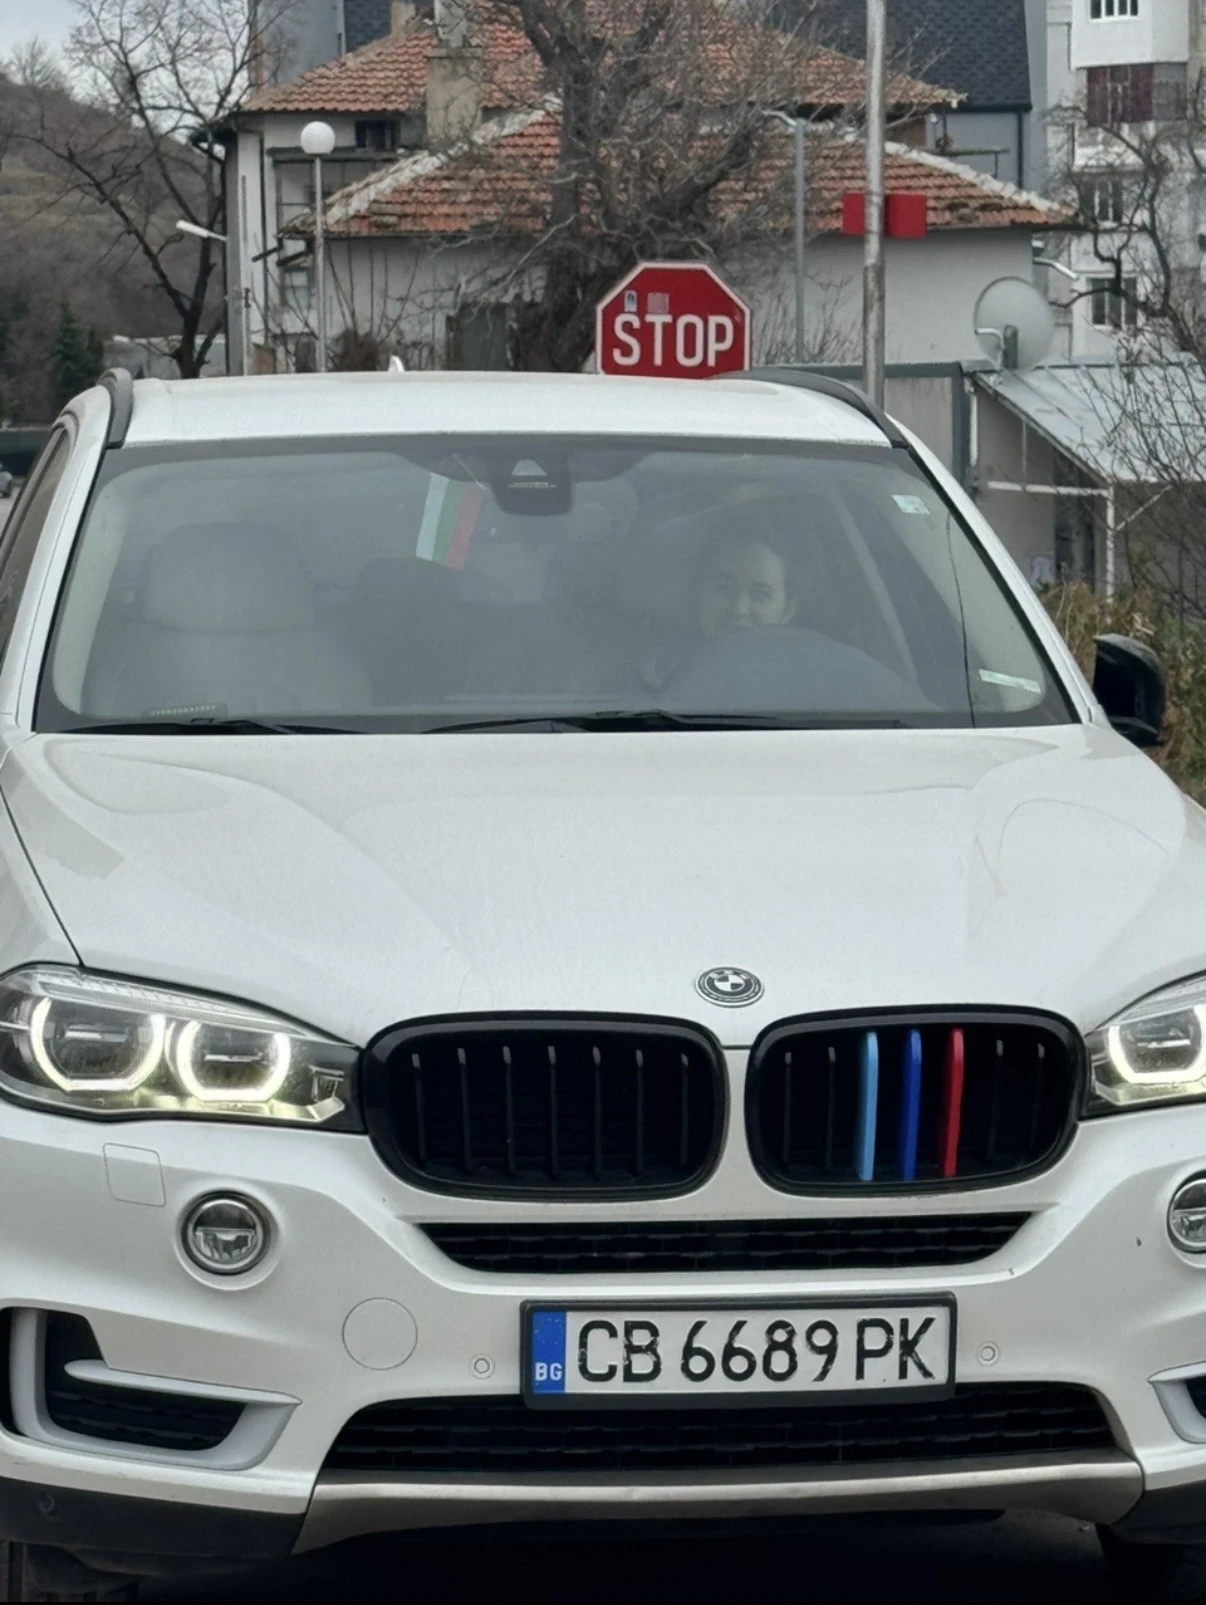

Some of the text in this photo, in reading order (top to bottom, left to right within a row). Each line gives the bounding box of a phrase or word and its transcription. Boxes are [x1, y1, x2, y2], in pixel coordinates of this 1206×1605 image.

[612, 313, 735, 368] STOP
[534, 1361, 563, 1382] BG
[577, 1317, 936, 1383] CB 6689 PK
